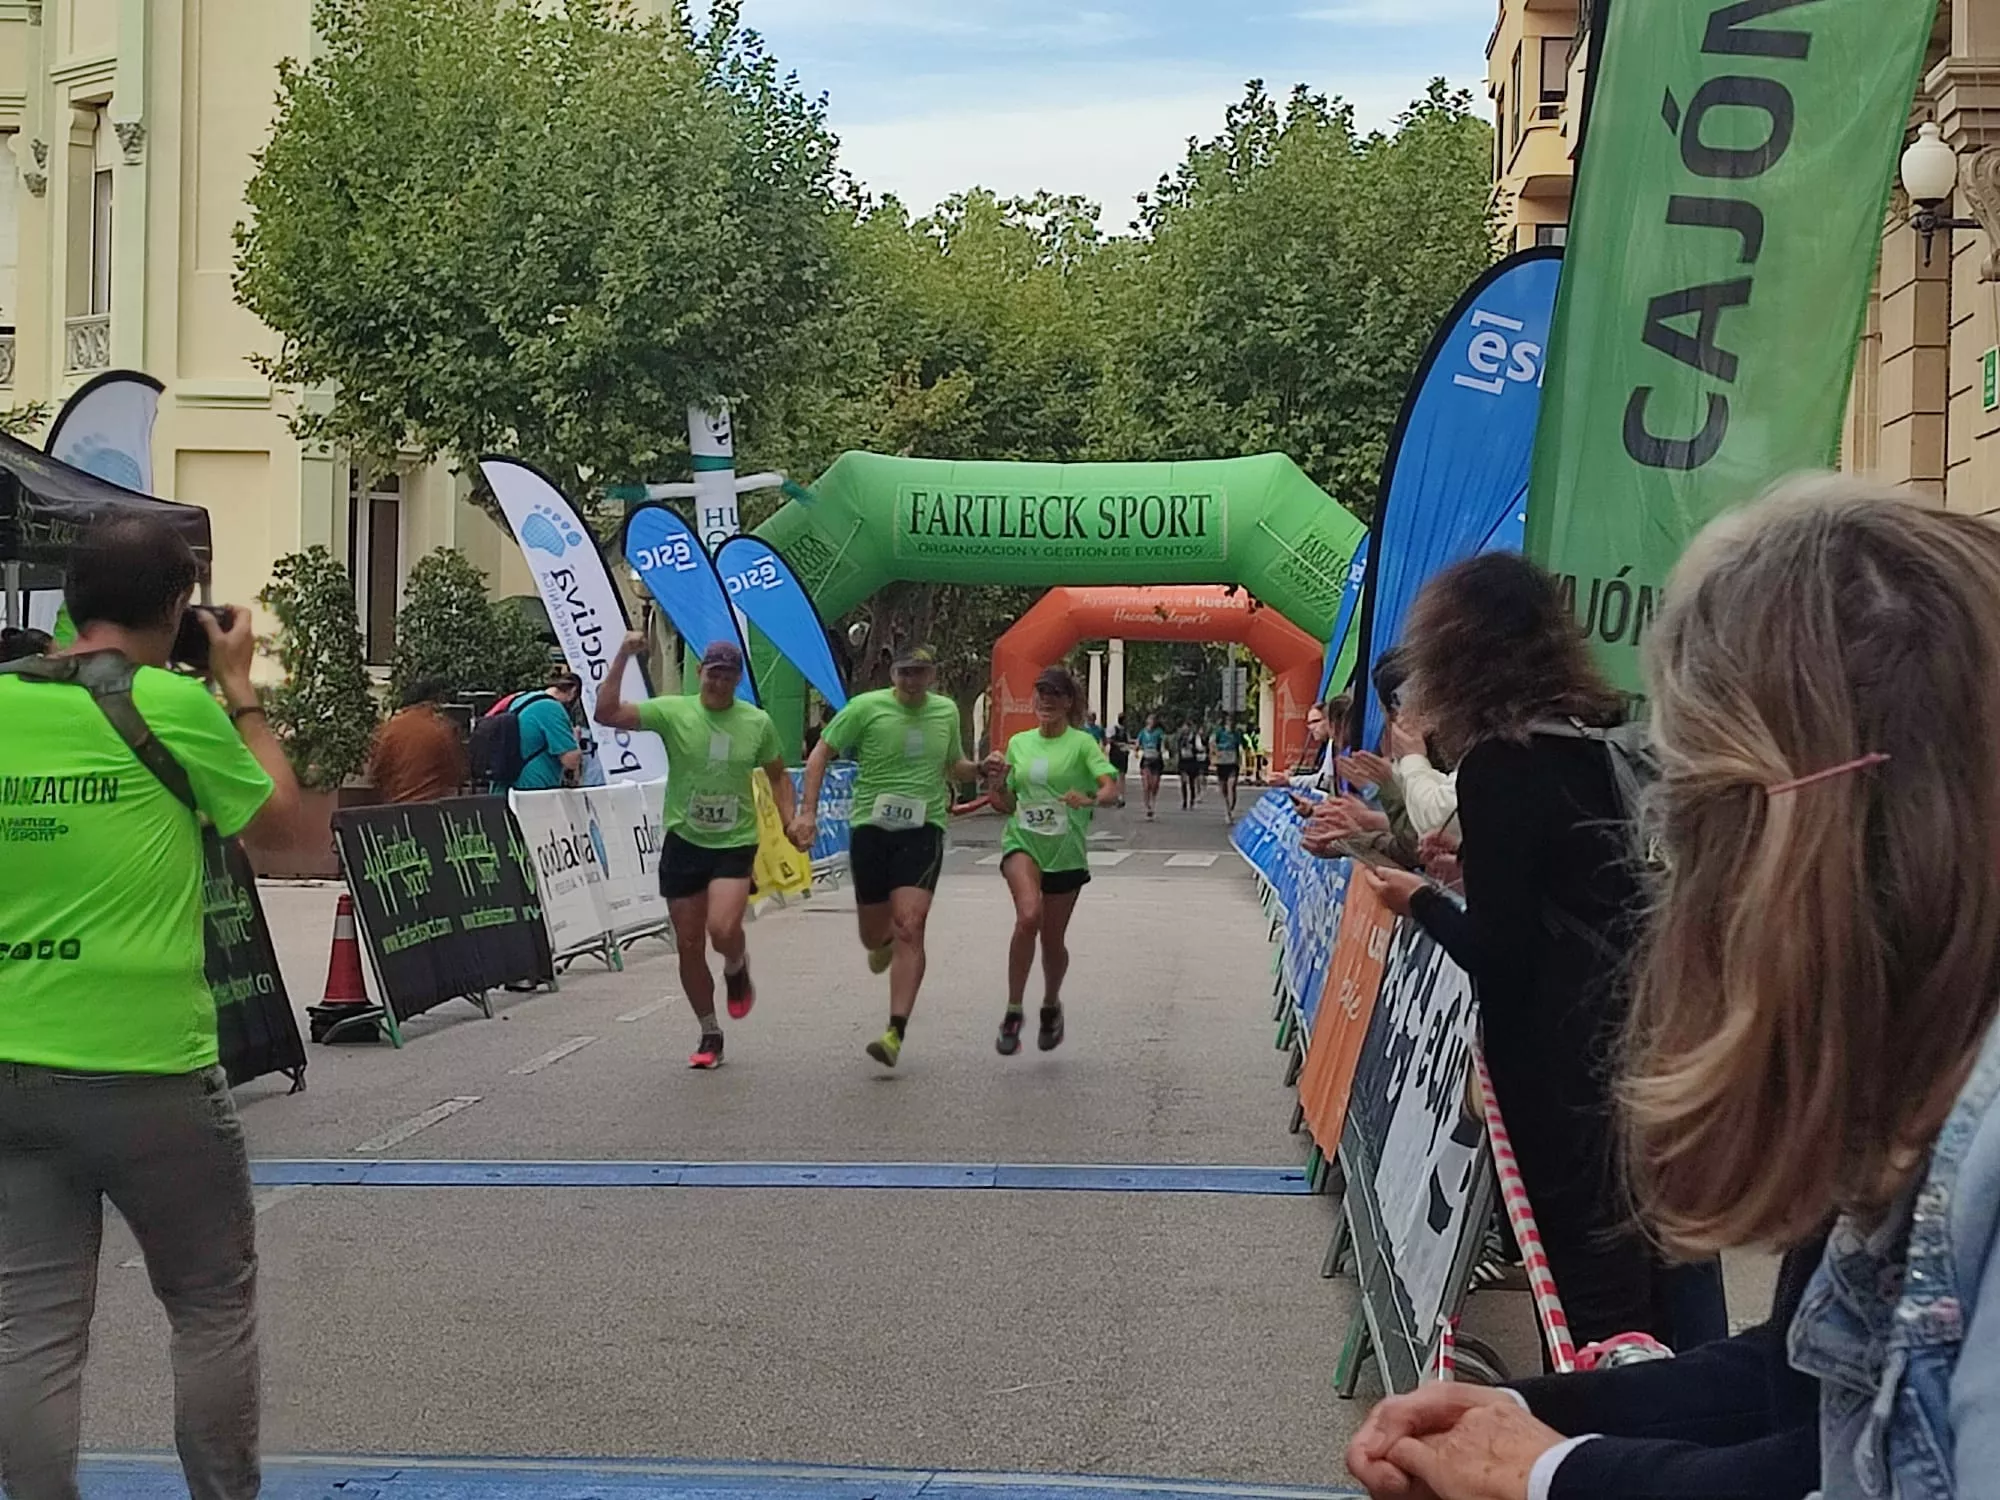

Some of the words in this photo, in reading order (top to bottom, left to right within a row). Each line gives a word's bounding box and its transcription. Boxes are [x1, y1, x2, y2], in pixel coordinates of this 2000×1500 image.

[908, 491, 1088, 540] FARTLECK
[1096, 493, 1212, 540] SPORT
[1195, 595, 1245, 608] Huesca
[0, 772, 119, 805] NIZACIÓN
